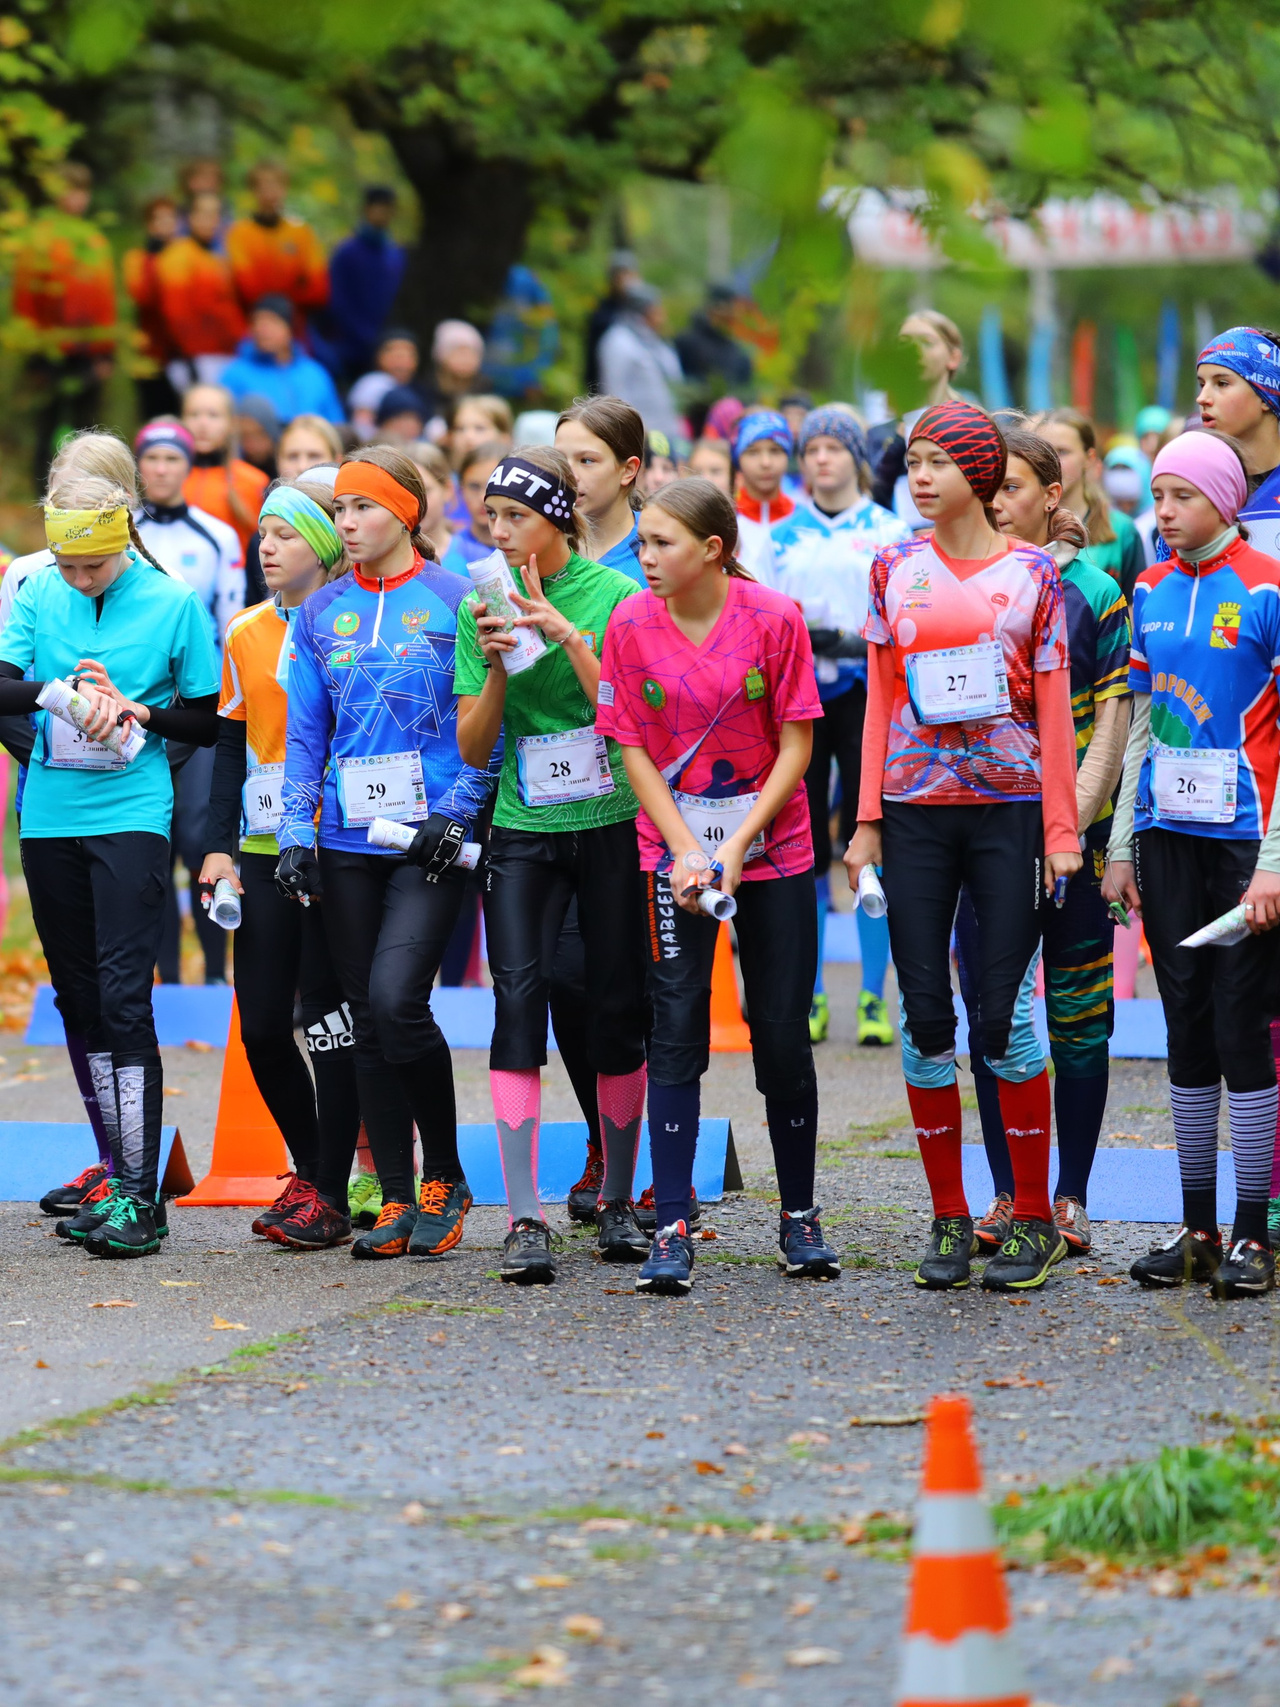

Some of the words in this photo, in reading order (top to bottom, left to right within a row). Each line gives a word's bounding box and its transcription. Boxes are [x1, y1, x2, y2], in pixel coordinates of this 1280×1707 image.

[1162, 621, 1175, 631] 18
[334, 653, 350, 663] SFR
[946, 675, 967, 691] 27
[549, 760, 571, 777] 28
[366, 783, 386, 800] 29
[1177, 777, 1196, 794] 26
[258, 794, 272, 811] 30
[703, 826, 724, 841] 40
